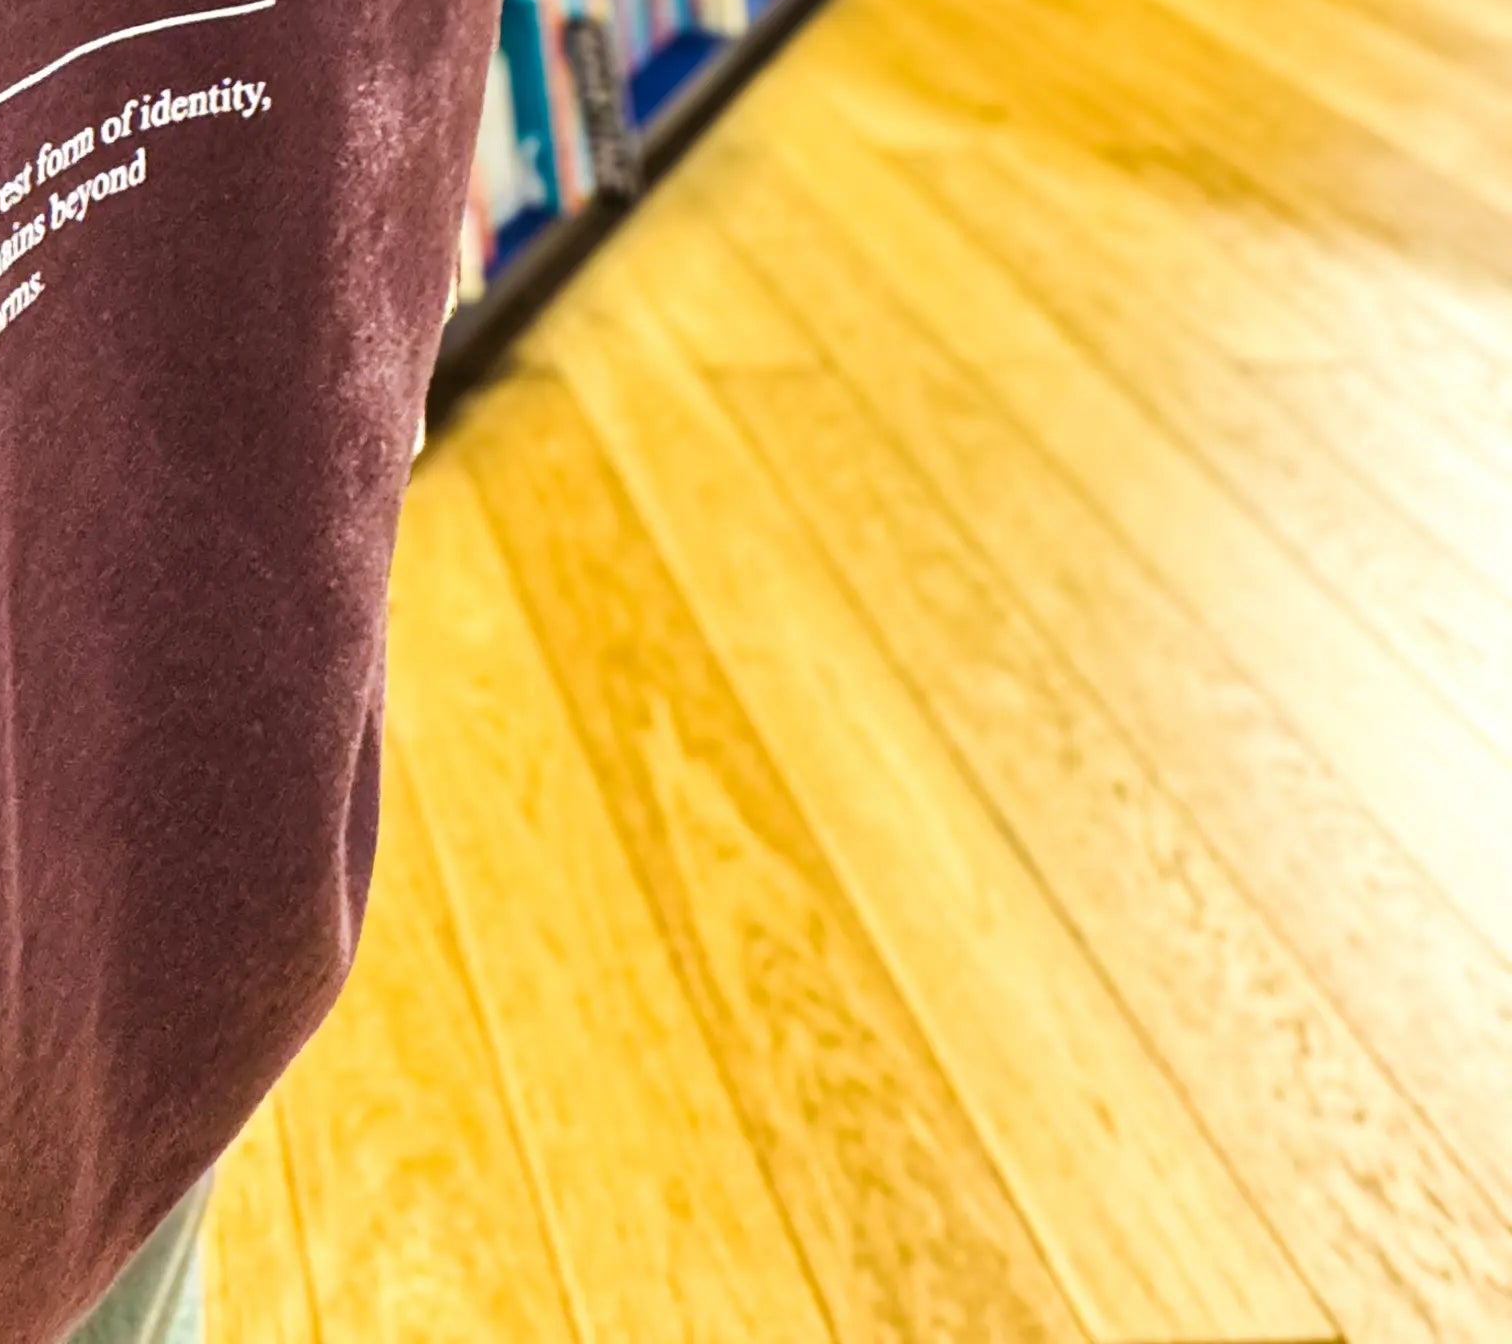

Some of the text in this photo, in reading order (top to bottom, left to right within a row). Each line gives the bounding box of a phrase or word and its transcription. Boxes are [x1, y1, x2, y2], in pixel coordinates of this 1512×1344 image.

[36, 125, 94, 186] form
[100, 98, 139, 145] of
[140, 77, 273, 131] identity,
[49, 147, 146, 230] beyond
